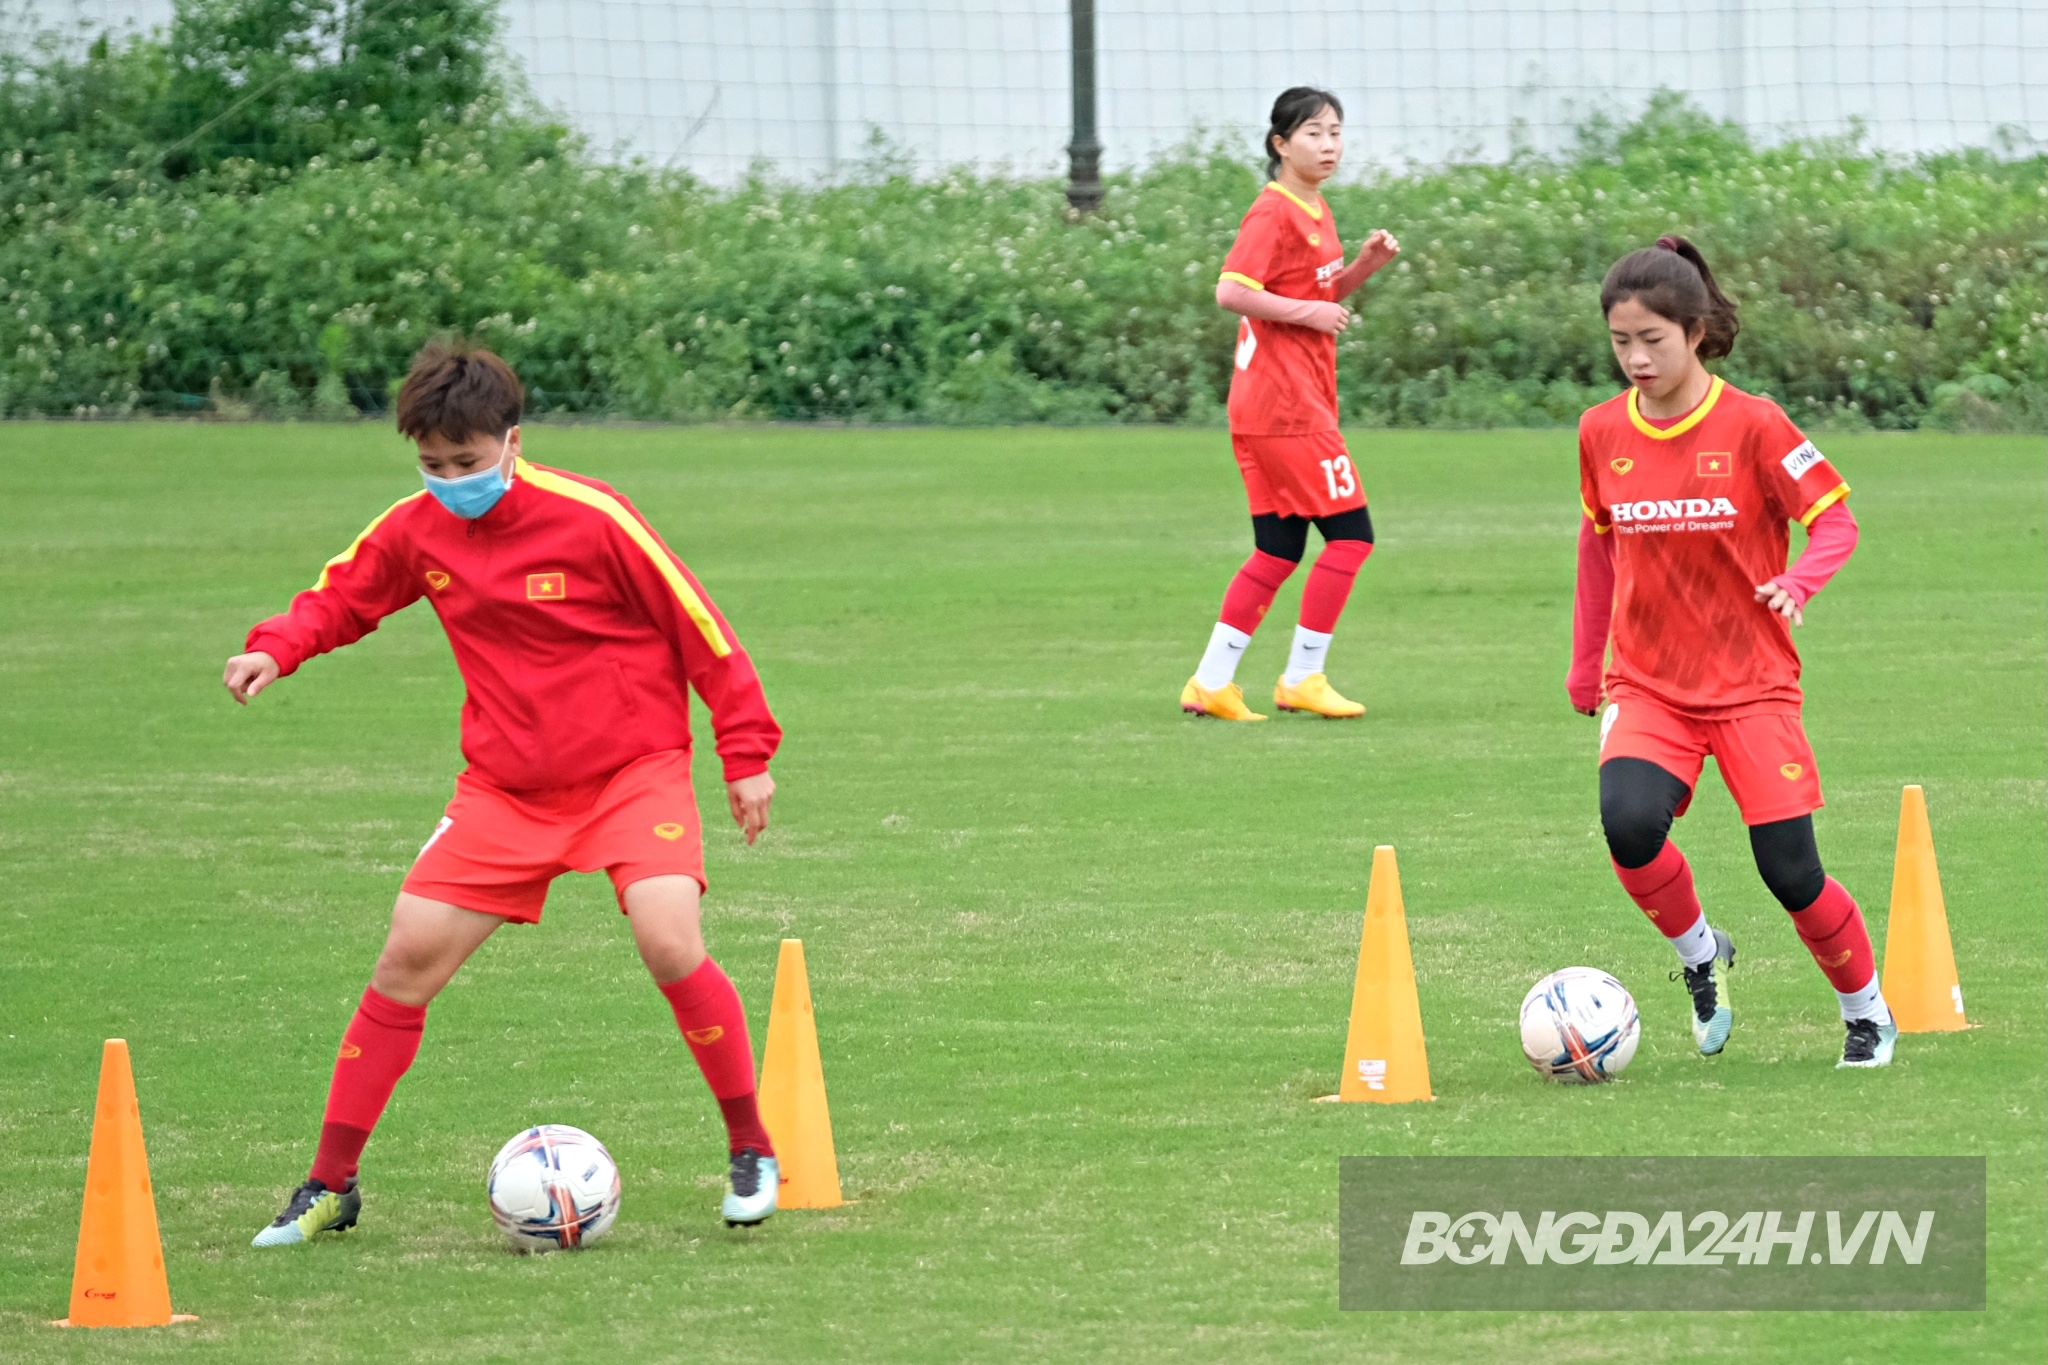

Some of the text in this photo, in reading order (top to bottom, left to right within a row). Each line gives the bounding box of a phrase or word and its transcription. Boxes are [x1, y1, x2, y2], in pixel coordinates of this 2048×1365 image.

[1320, 454, 1356, 500] 13
[1610, 497, 1738, 522] HONDA
[1618, 519, 1735, 535] The Power of Dreams
